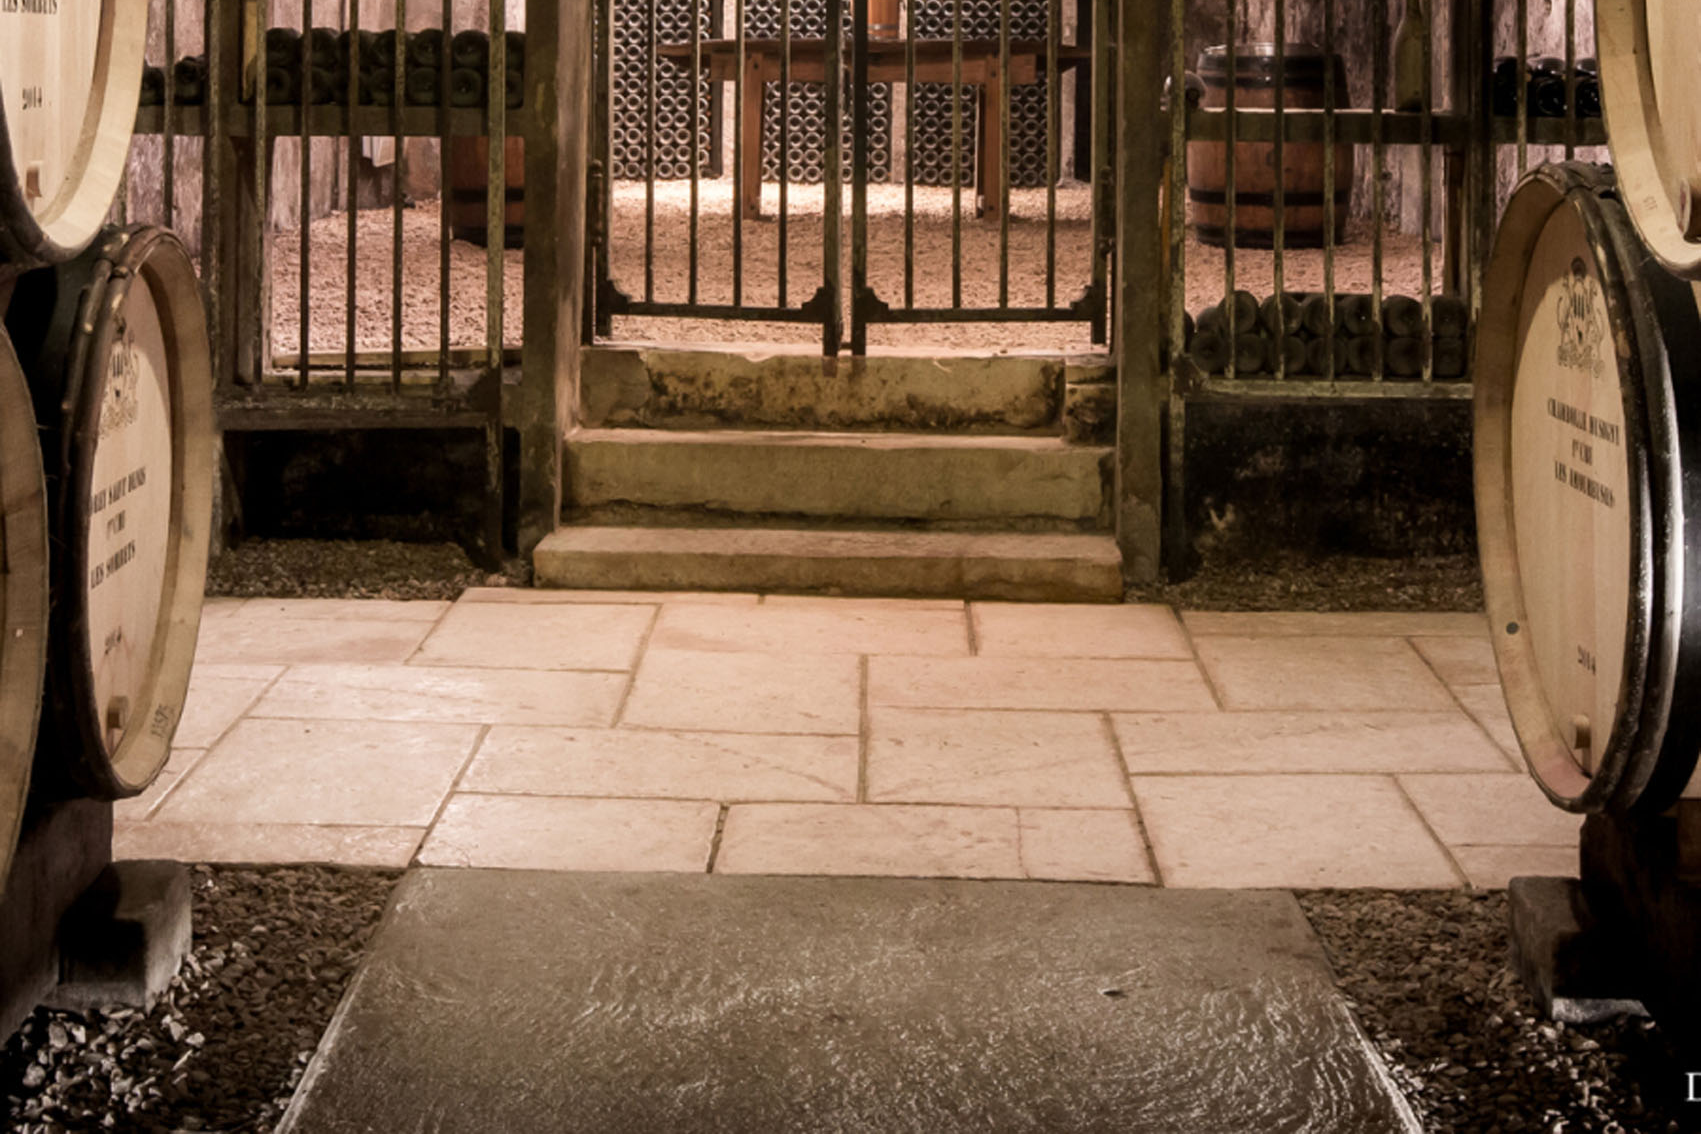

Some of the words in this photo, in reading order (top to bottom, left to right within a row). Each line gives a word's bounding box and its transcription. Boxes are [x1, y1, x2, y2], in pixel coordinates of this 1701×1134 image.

[22, 86, 42, 111] 2014
[1555, 460, 1567, 484] LES
[91, 562, 104, 590] LES
